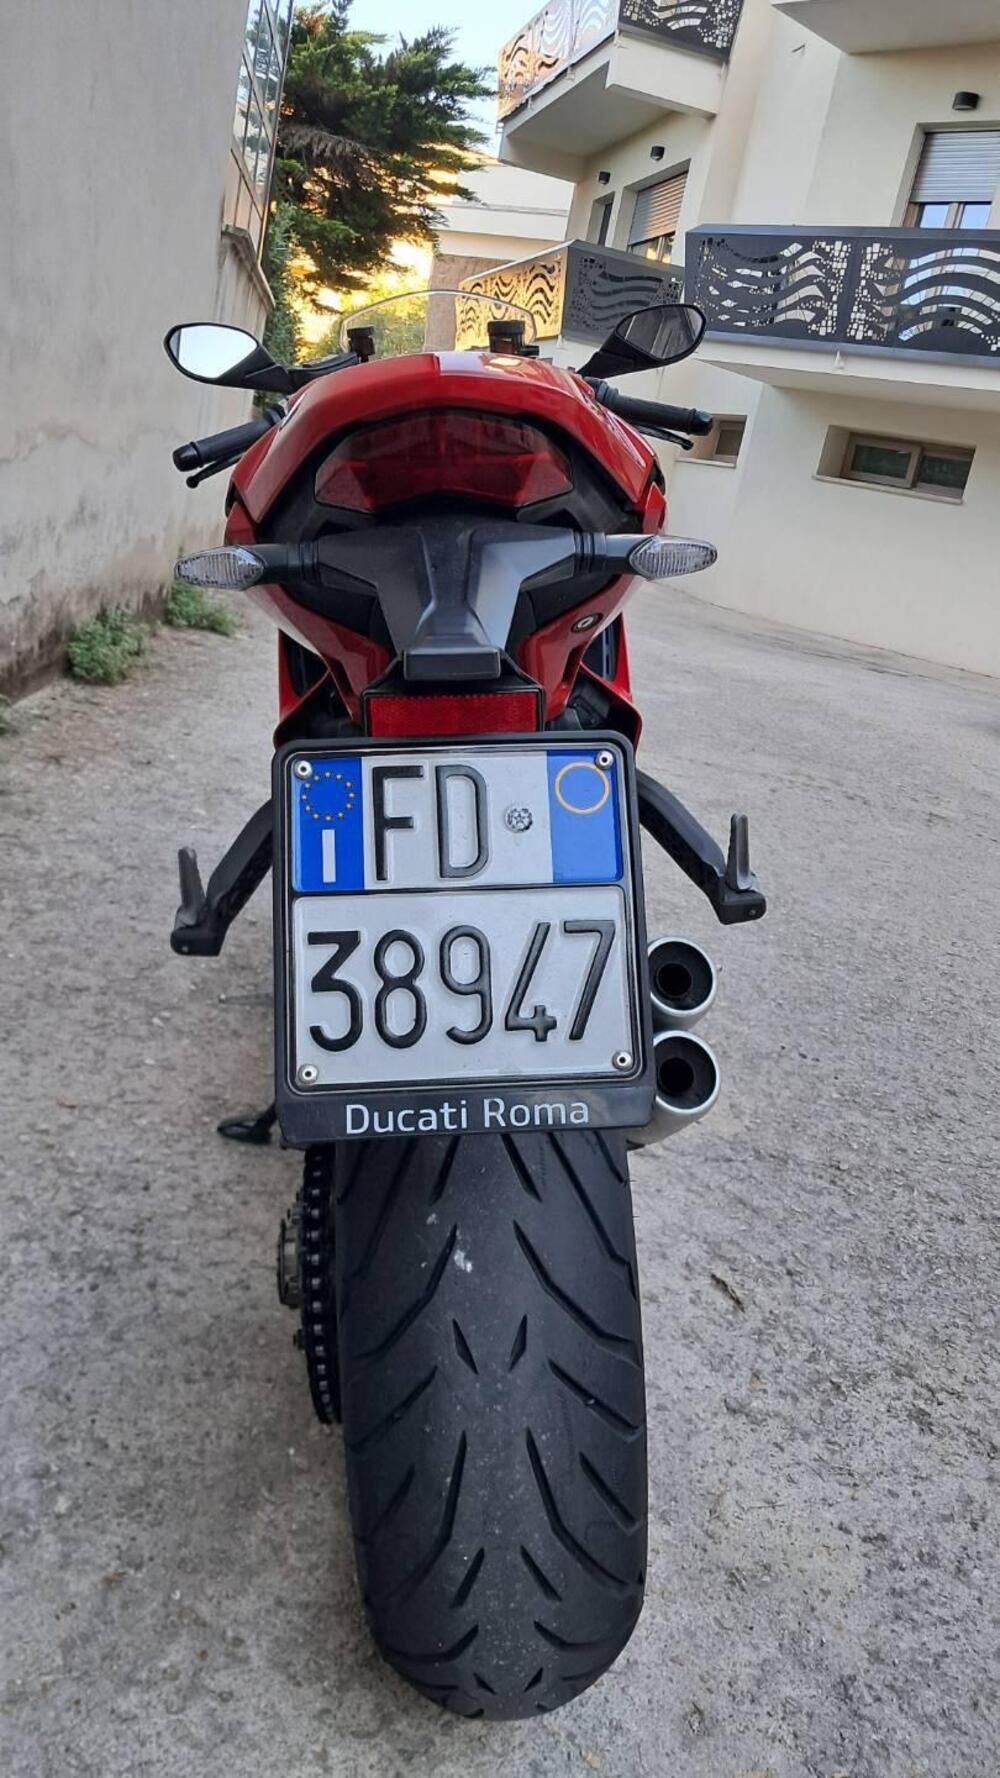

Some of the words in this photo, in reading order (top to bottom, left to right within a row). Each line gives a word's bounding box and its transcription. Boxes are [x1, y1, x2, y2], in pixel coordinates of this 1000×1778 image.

[322, 829, 336, 882] I
[372, 765, 488, 880] FD
[307, 920, 615, 1052] 38947
[346, 1100, 468, 1134] Ducati
[483, 1098, 590, 1128] Roma
